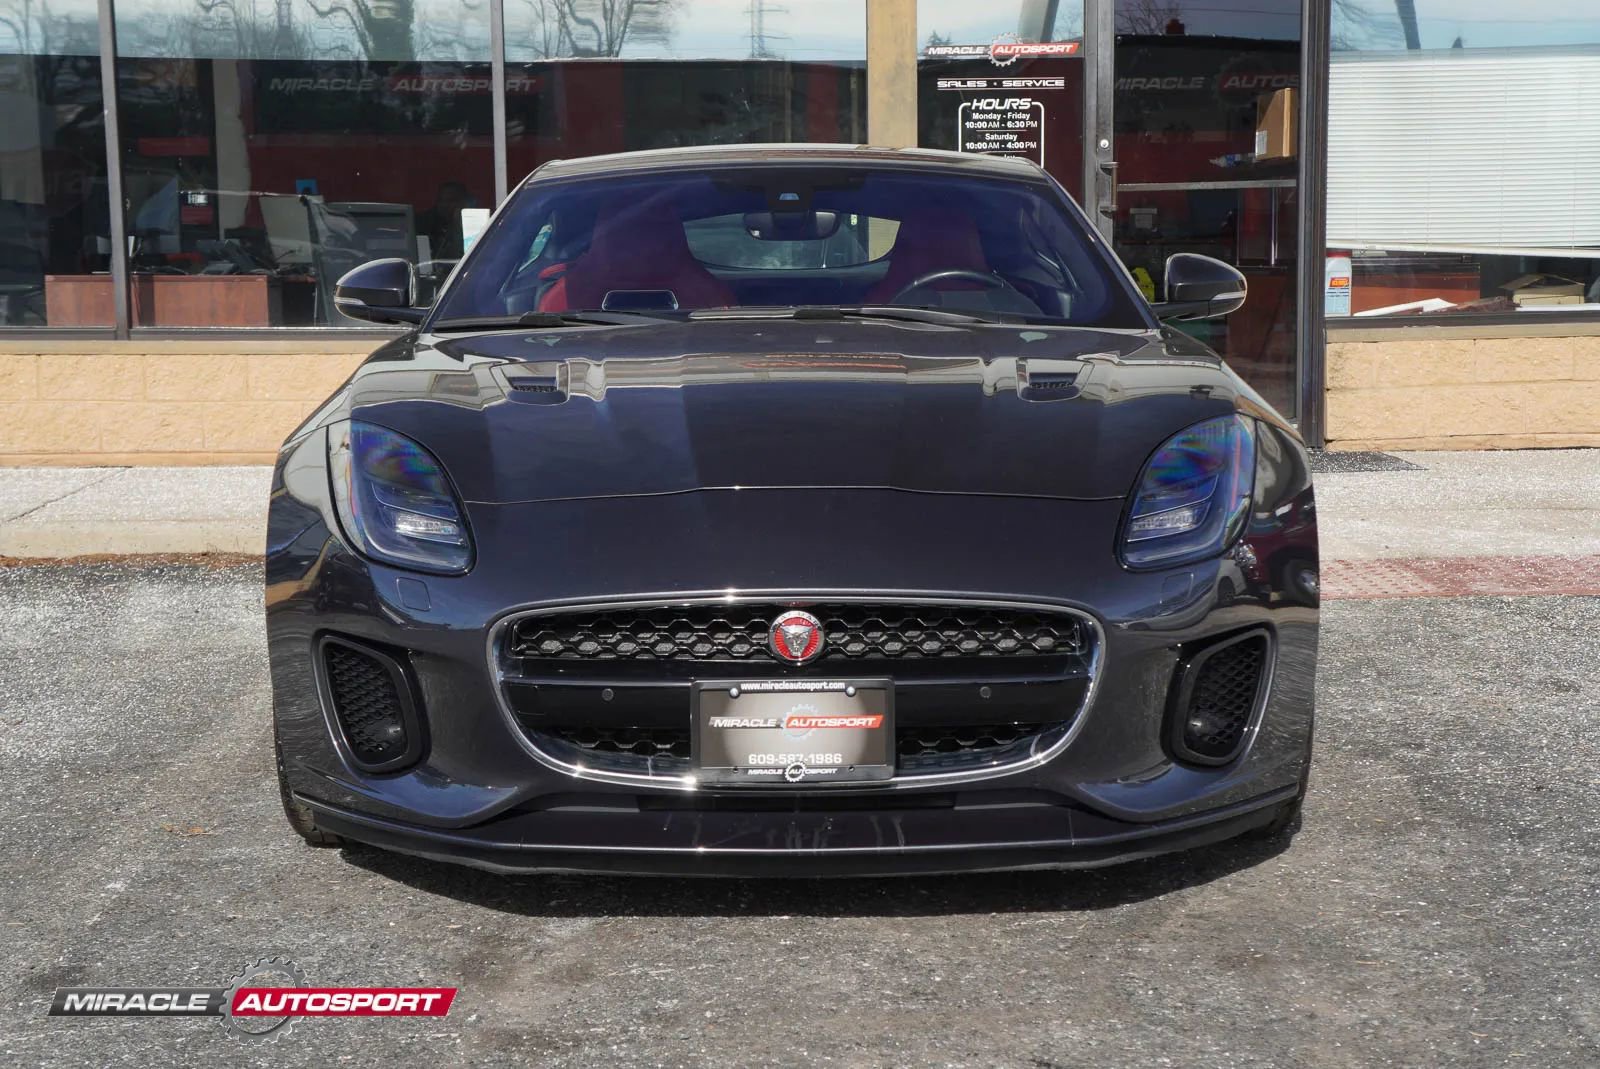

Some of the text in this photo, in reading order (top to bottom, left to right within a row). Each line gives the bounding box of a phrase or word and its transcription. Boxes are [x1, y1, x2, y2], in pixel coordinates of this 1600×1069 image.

[928, 44, 1073, 55] MIRACLE AUTOSPORT
[270, 78, 536, 92] MIRACLE AUTOSPRT
[937, 79, 1065, 88] SALES SERVICE
[971, 98, 1032, 110] HOURS
[972, 112, 1001, 121] Monday
[1007, 112, 1030, 121] Friday
[965, 121, 987, 129] 10:00
[988, 121, 1000, 129] AM
[1007, 121, 1025, 129] 6:30
[985, 133, 1018, 141] Saturday
[740, 681, 845, 691] www.miracleautosport.com
[713, 717, 877, 728] MIRACLE AUTOSPORT
[748, 753, 842, 764] 609-587-1986
